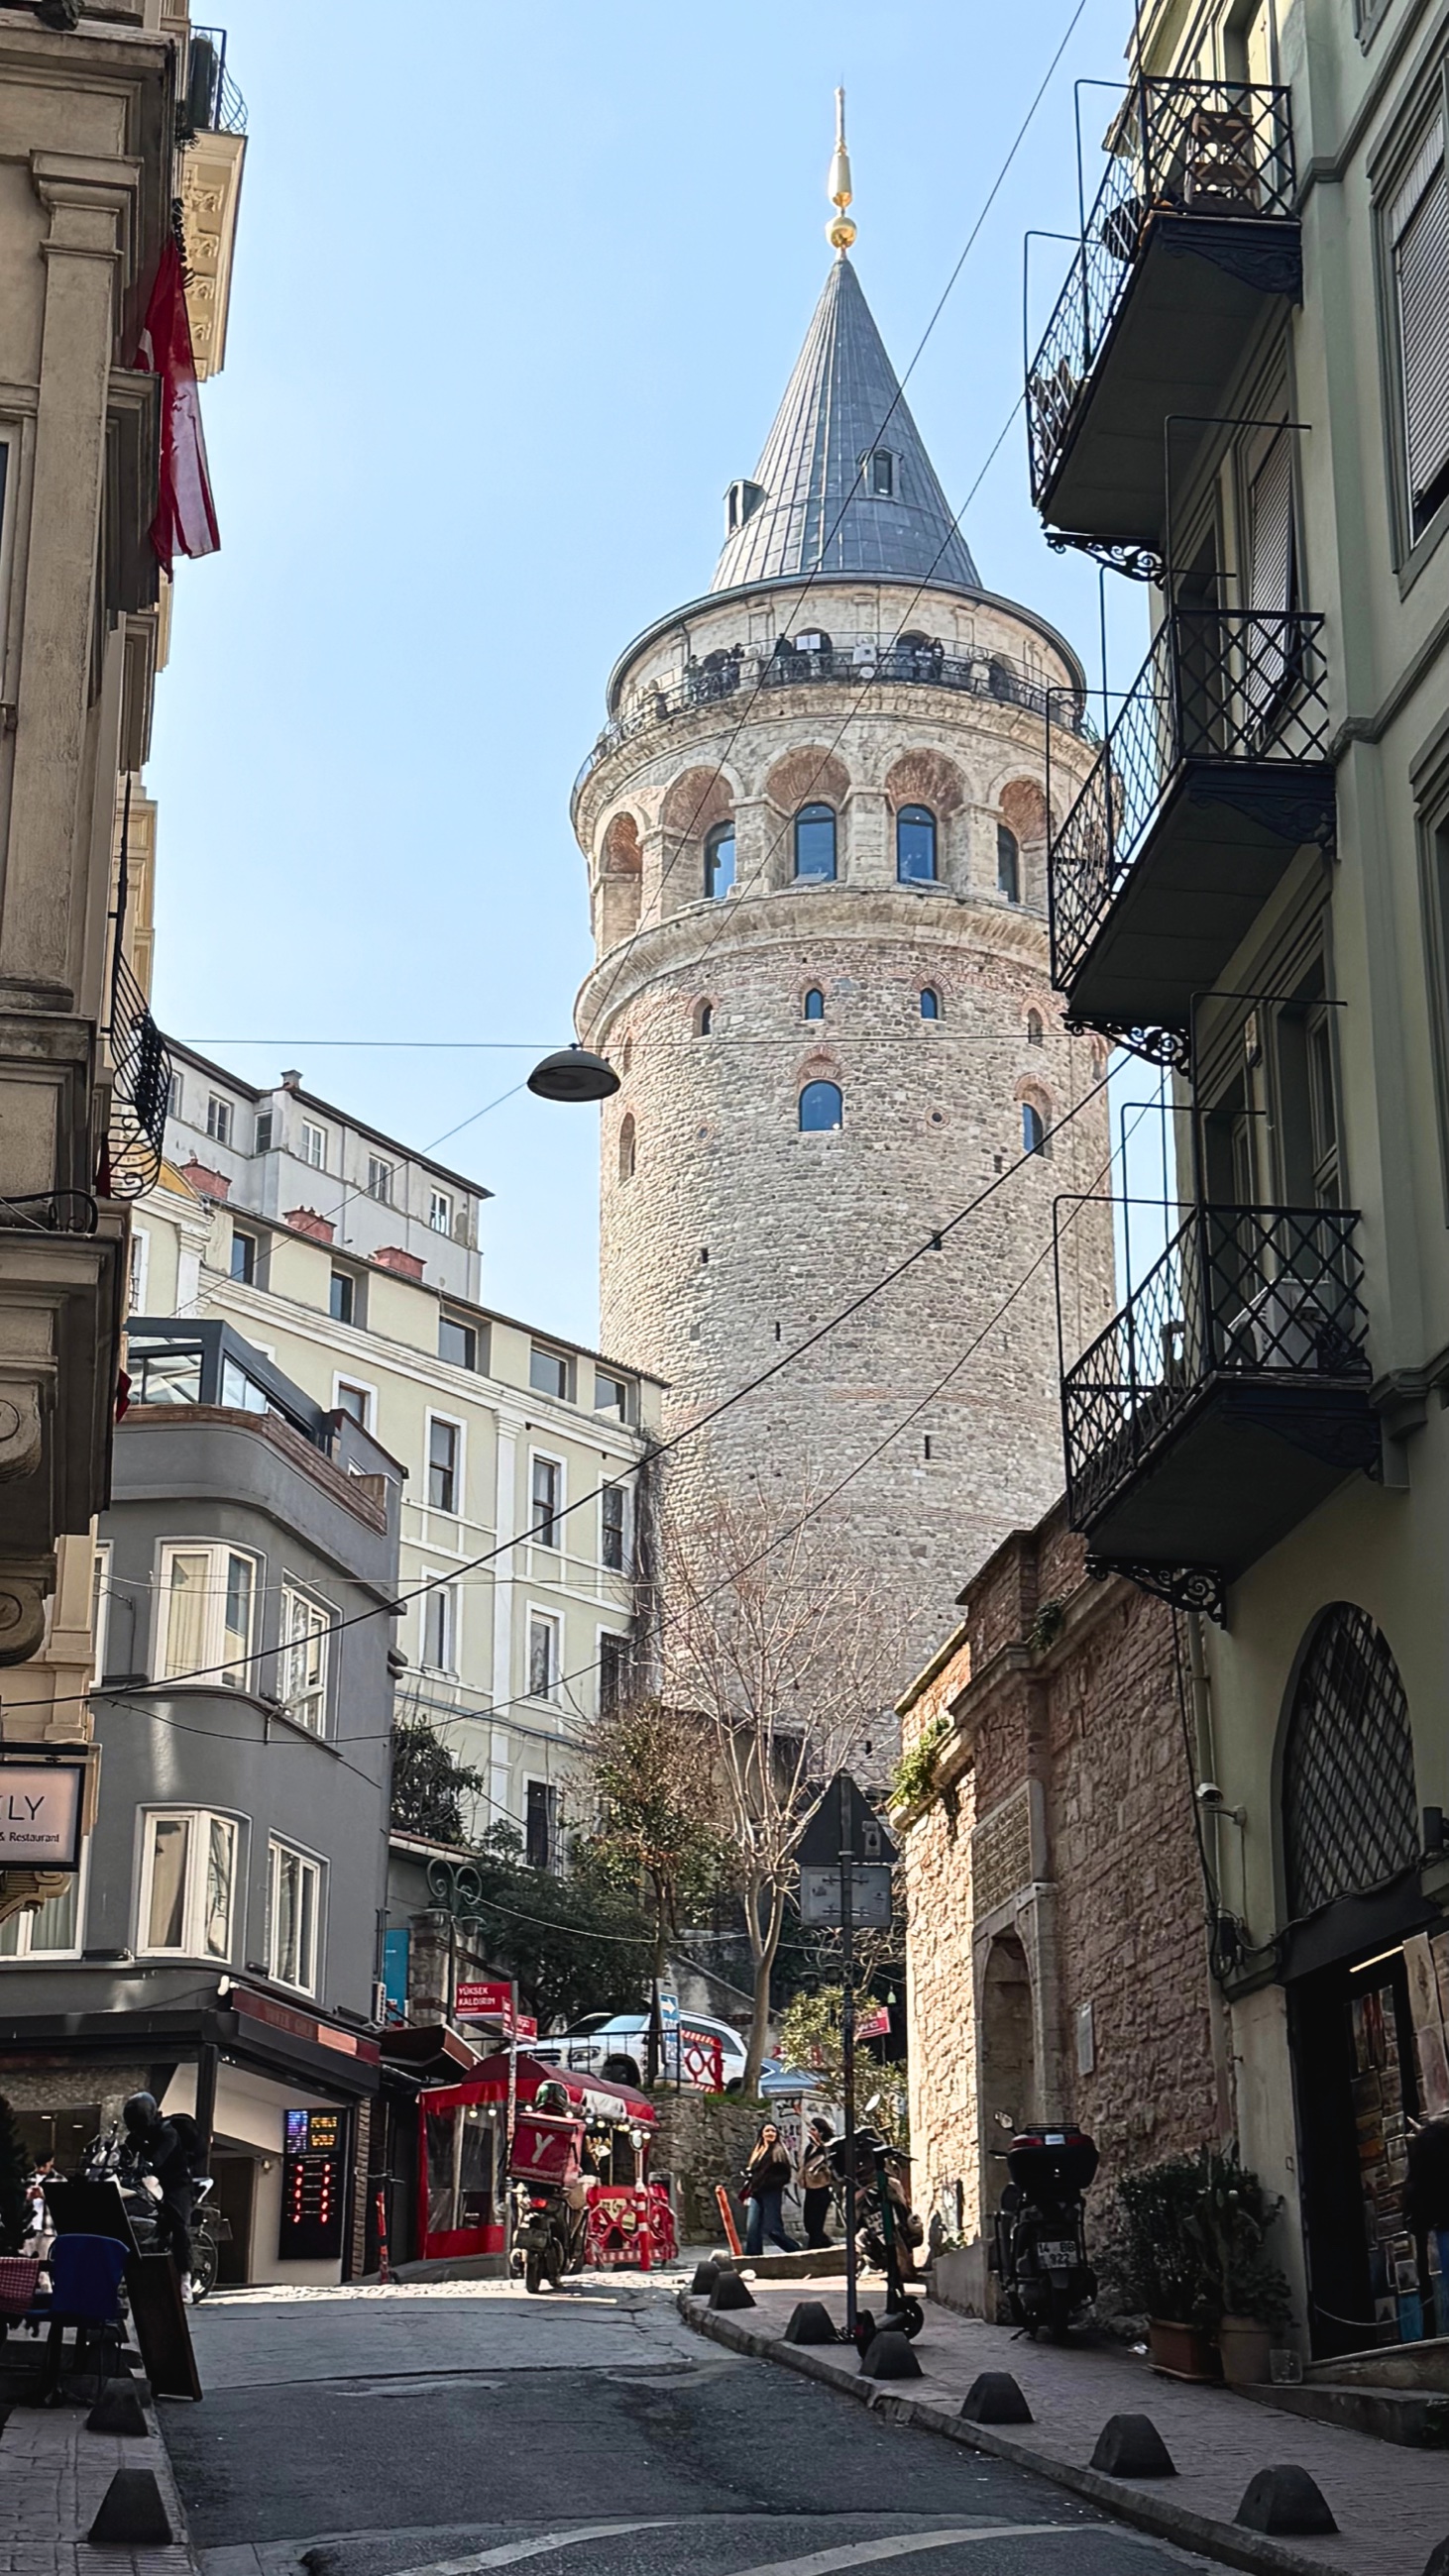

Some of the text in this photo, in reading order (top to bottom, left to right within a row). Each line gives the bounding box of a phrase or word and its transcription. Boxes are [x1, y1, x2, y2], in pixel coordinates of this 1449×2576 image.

[0, 1795, 45, 1821] LY
[9, 1832, 59, 1843] Restaurant
[458, 1986, 489, 1996] YÜKSEK
